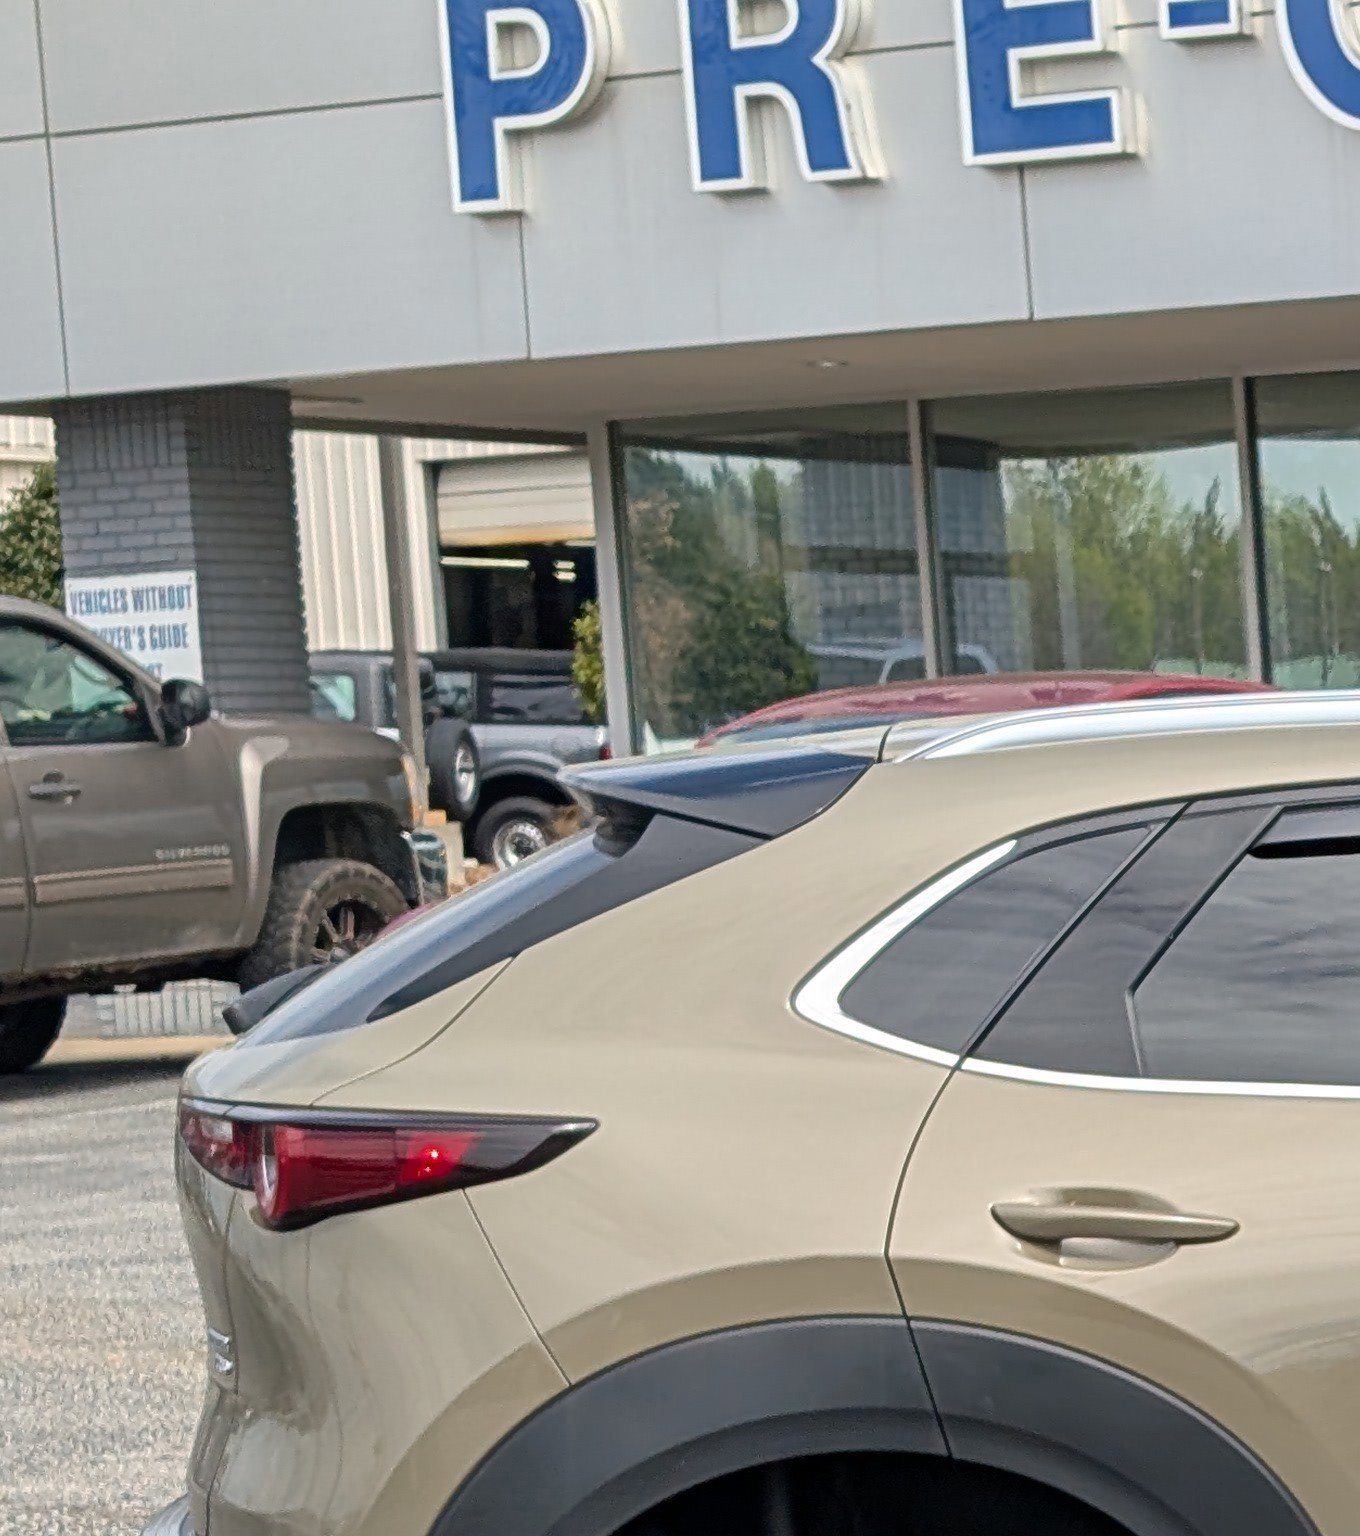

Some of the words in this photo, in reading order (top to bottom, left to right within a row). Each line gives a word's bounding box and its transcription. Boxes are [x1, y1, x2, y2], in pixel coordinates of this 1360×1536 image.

[69, 587, 128, 616] VEHICLES
[131, 584, 192, 613] WITHOUT
[149, 622, 189, 651] GUIDE
